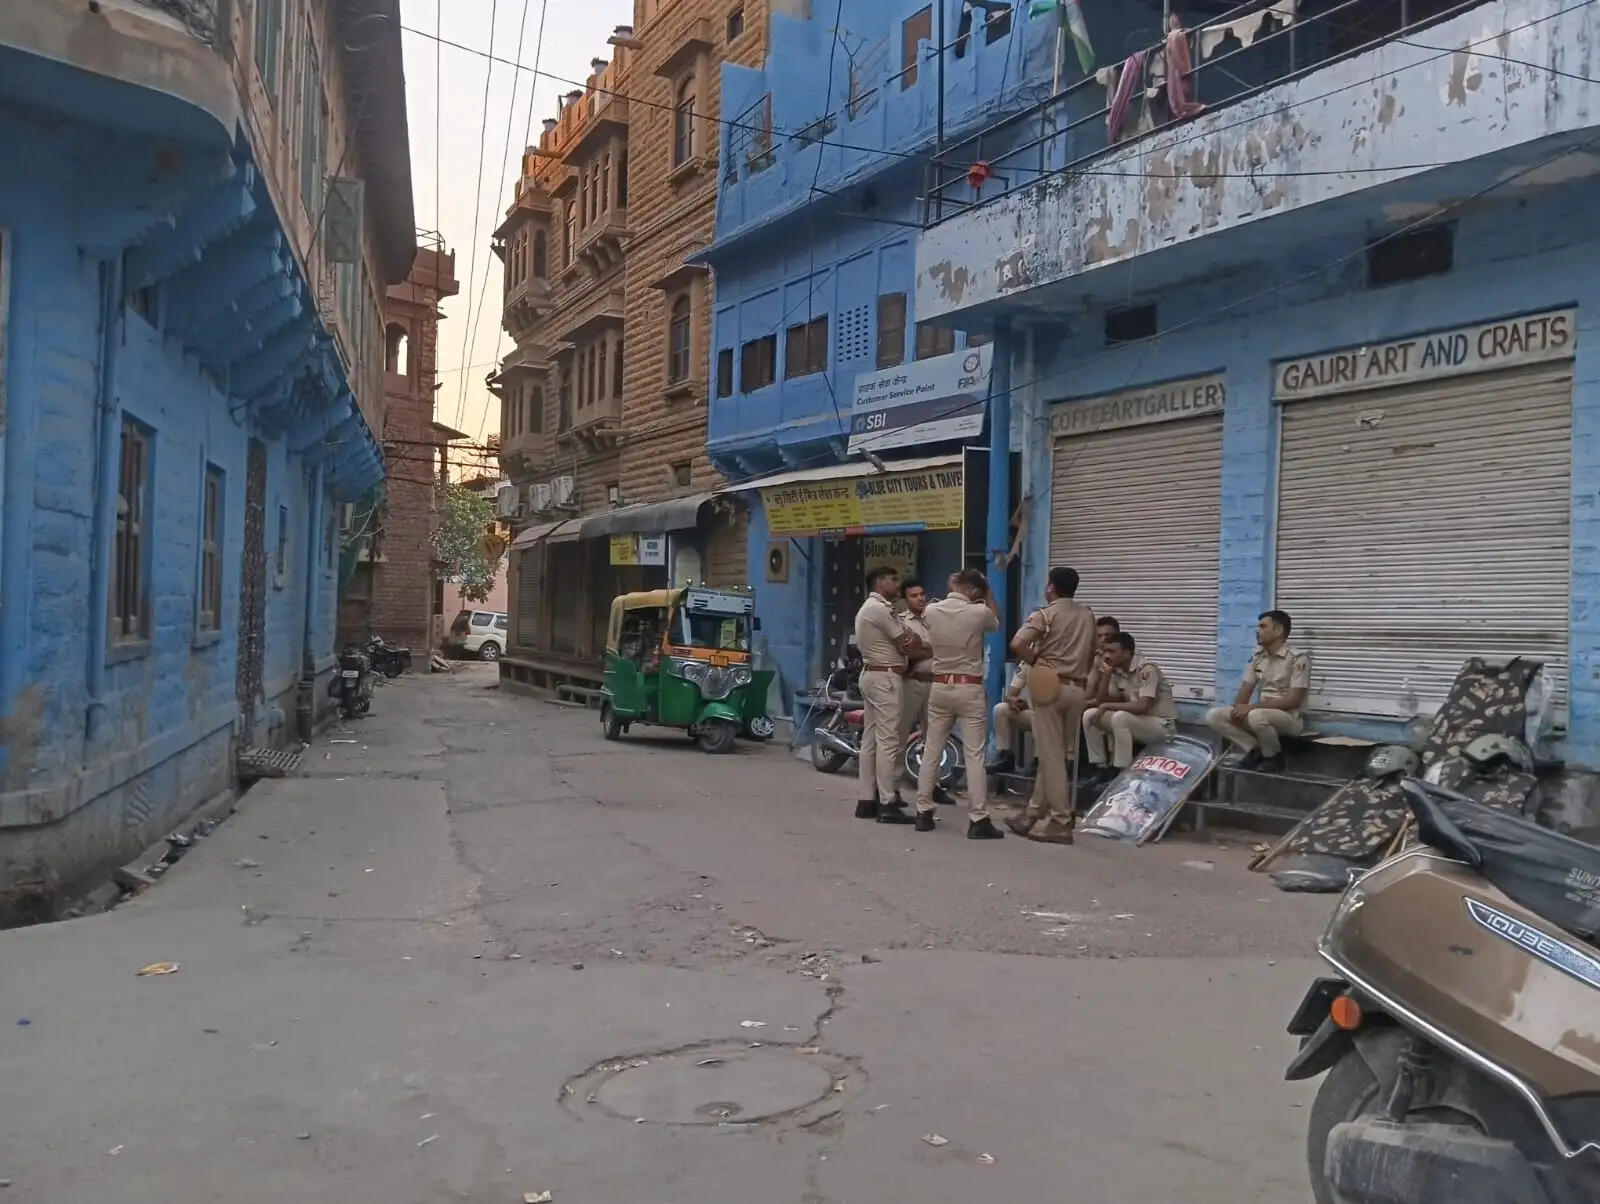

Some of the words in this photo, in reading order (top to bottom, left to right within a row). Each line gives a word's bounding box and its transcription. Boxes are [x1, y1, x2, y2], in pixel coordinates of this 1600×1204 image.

[1282, 352, 1357, 391] GAURI
[1364, 342, 1416, 378] ART
[1420, 333, 1468, 369] AND
[1477, 316, 1568, 361] CRAFTS
[857, 393, 888, 406] Customer
[888, 388, 914, 402] Service
[915, 383, 935, 395] Point
[866, 412, 887, 430] SBI
[887, 479, 903, 494] CITY
[903, 475, 929, 492] TOURS
[929, 474, 937, 490] &
[864, 540, 887, 558] Blue
[890, 538, 915, 559] City
